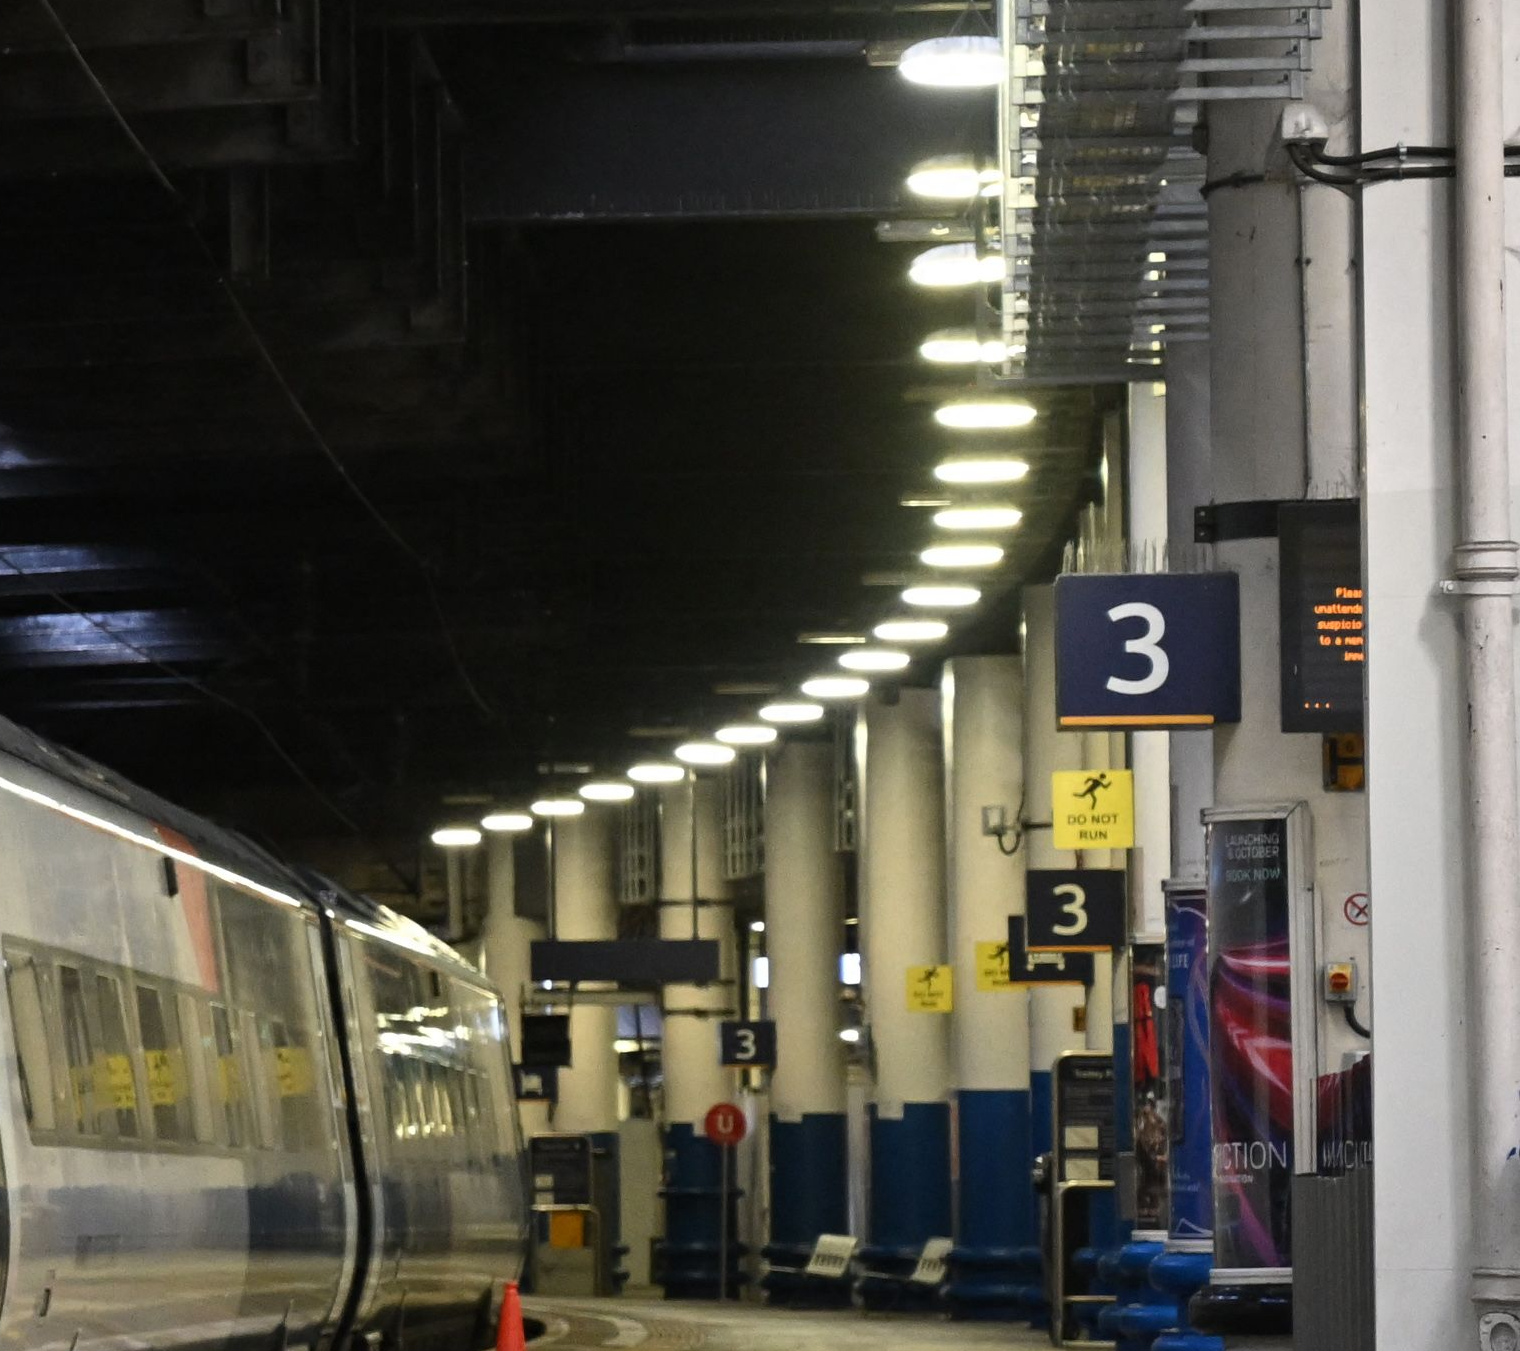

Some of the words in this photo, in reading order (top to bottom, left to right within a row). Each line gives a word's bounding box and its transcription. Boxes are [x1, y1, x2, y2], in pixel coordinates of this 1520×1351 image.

[1106, 601, 1170, 695] 3
[1067, 815, 1087, 825] DO
[1091, 814, 1119, 825] NOT
[1079, 830, 1108, 840] RUN
[1225, 833, 1279, 848] LAUNCHING
[1235, 846, 1279, 859] OCTOBER
[1225, 868, 1251, 882] BOOK
[1254, 867, 1281, 881] NOW
[1052, 883, 1088, 936] 3
[735, 1028, 756, 1060] 3
[717, 1114, 734, 1133] U
